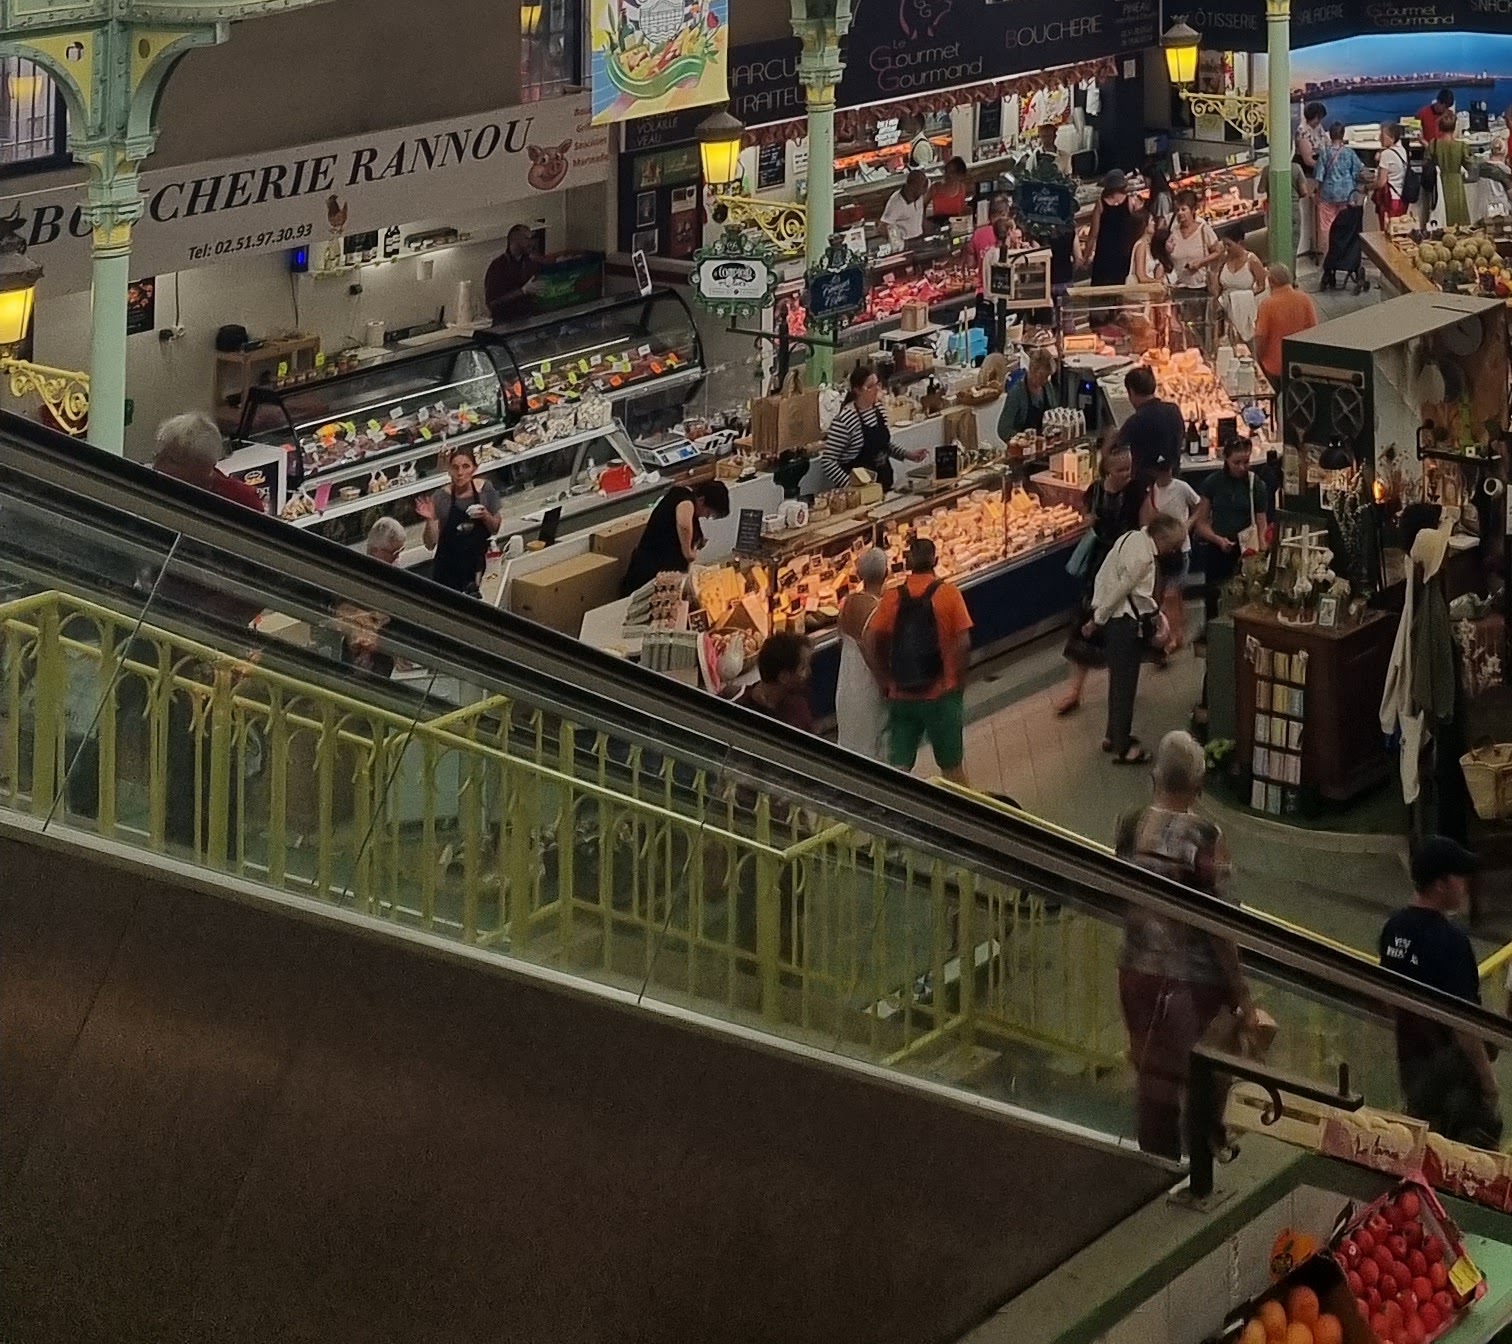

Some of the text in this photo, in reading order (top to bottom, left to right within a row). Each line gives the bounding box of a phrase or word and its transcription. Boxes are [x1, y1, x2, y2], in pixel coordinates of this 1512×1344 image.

[1006, 14, 1102, 49] BOUCHERIE
[869, 42, 961, 72] Gourmet
[878, 56, 983, 92] Gourmand
[28, 117, 535, 247] BOCHERIE RANNOU
[188, 223, 313, 261] Tel: 02.51.97.30.93
